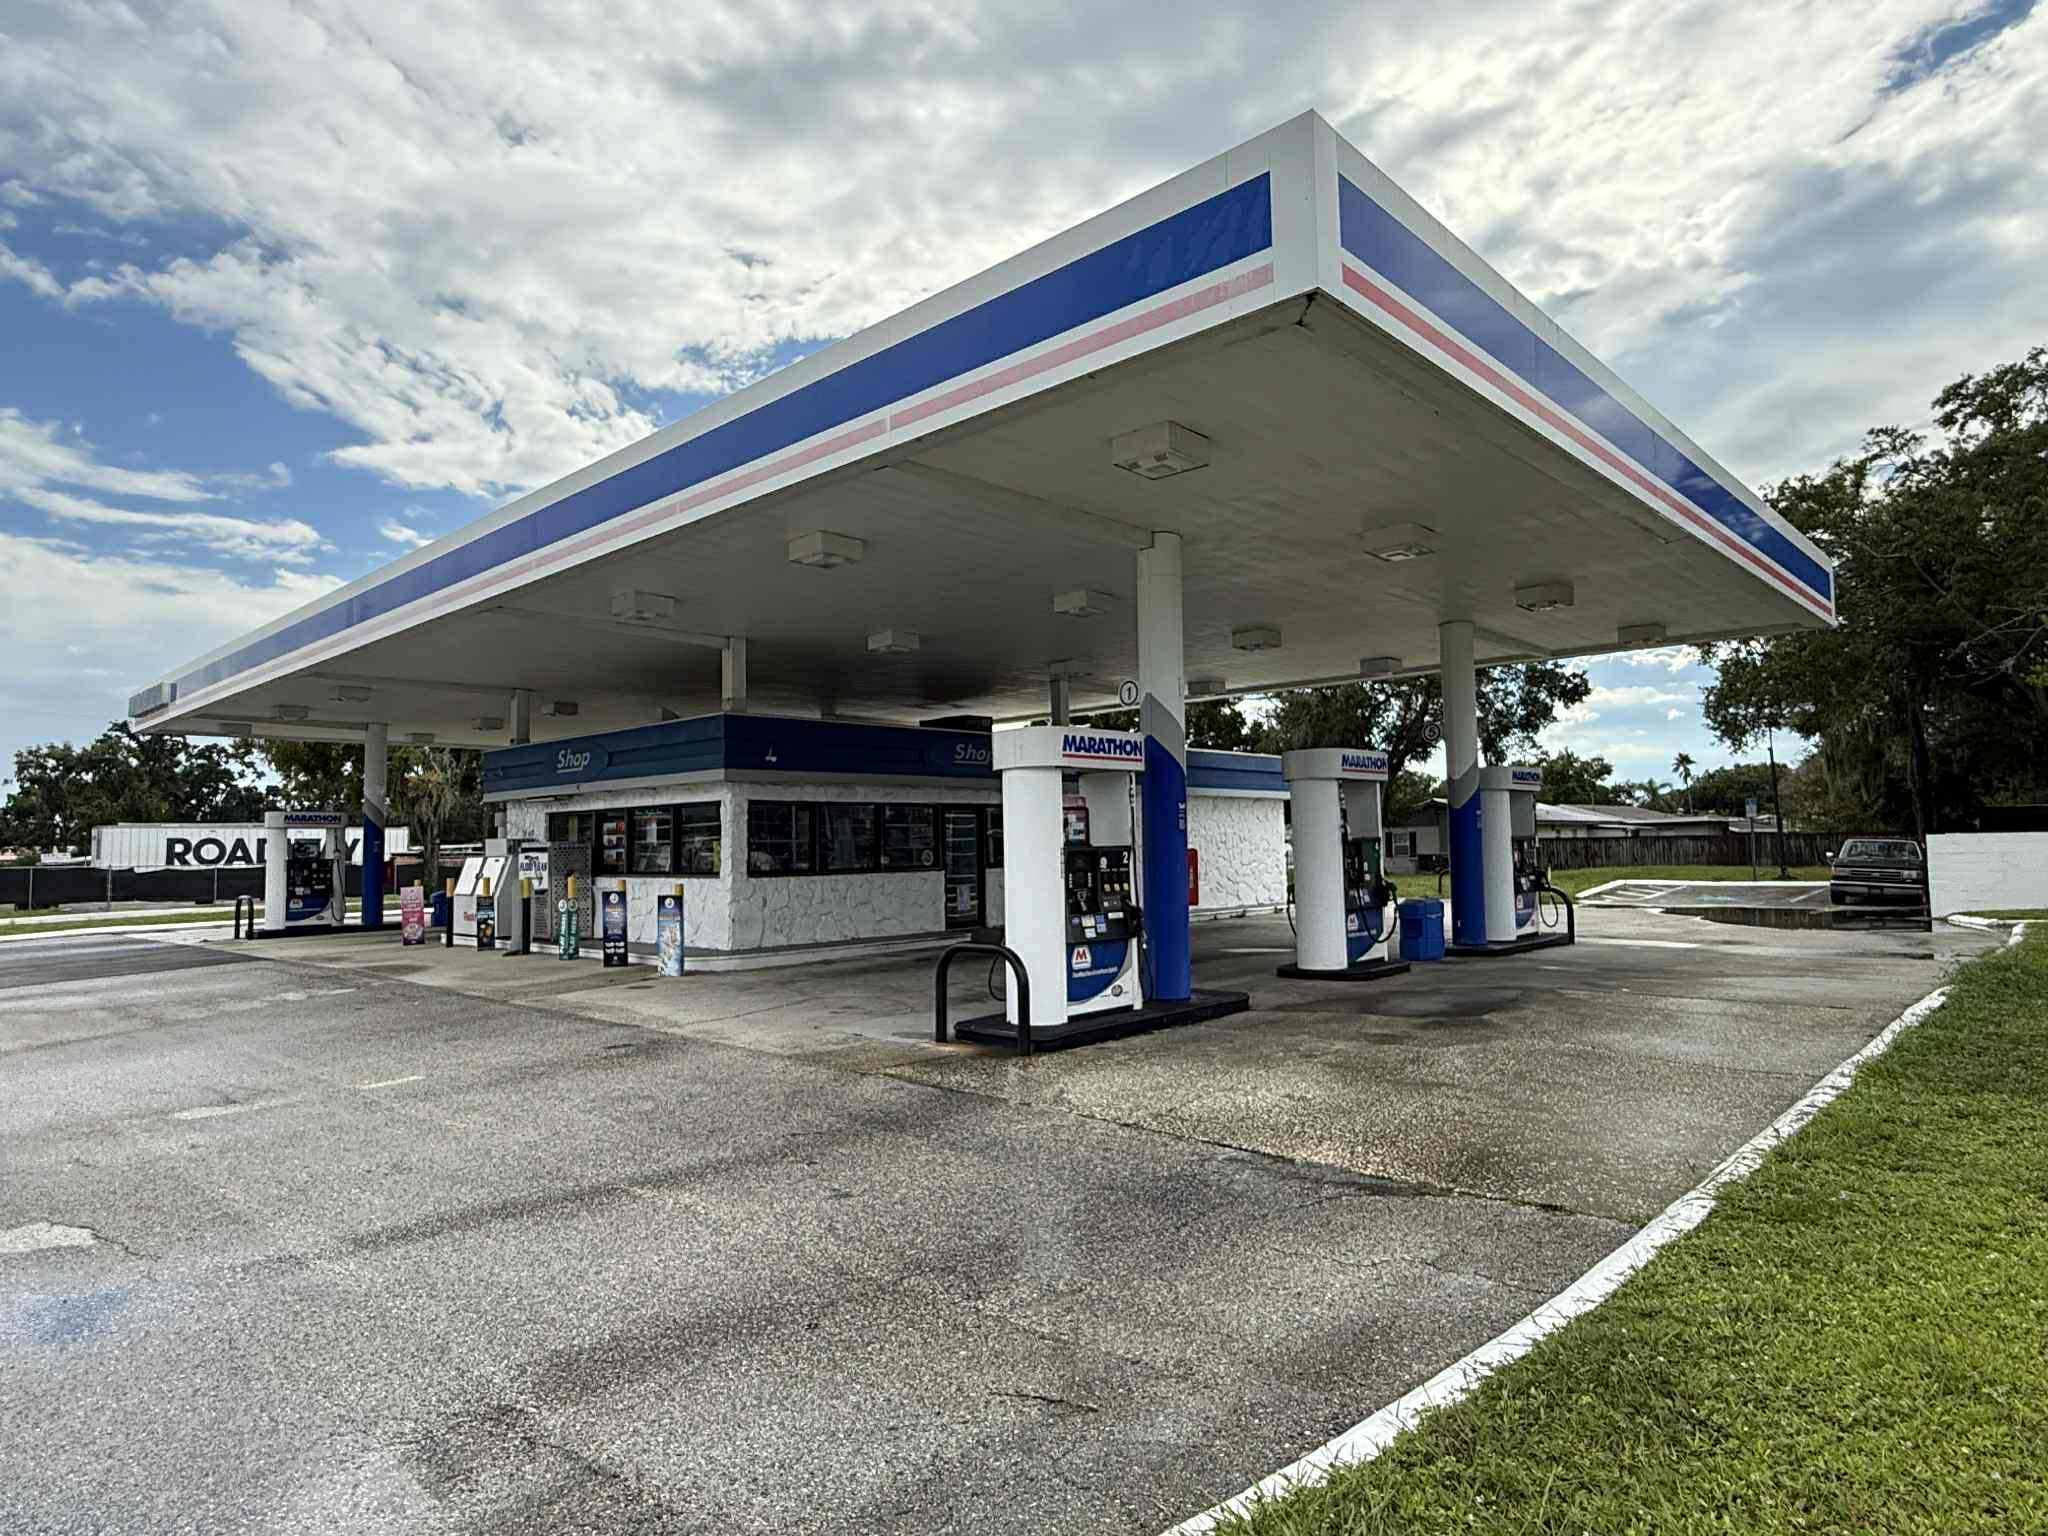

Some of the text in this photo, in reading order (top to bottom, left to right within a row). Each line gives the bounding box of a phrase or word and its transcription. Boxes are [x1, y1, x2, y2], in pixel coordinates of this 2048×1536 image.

[1062, 734, 1143, 757] MARATHON
[556, 748, 591, 771] Shop
[1341, 753, 1390, 771] MARATHON
[283, 813, 342, 824] MARATHON
[166, 837, 361, 865] ROAY
[1122, 851, 1129, 864] 2
[1076, 949, 1088, 961] M
